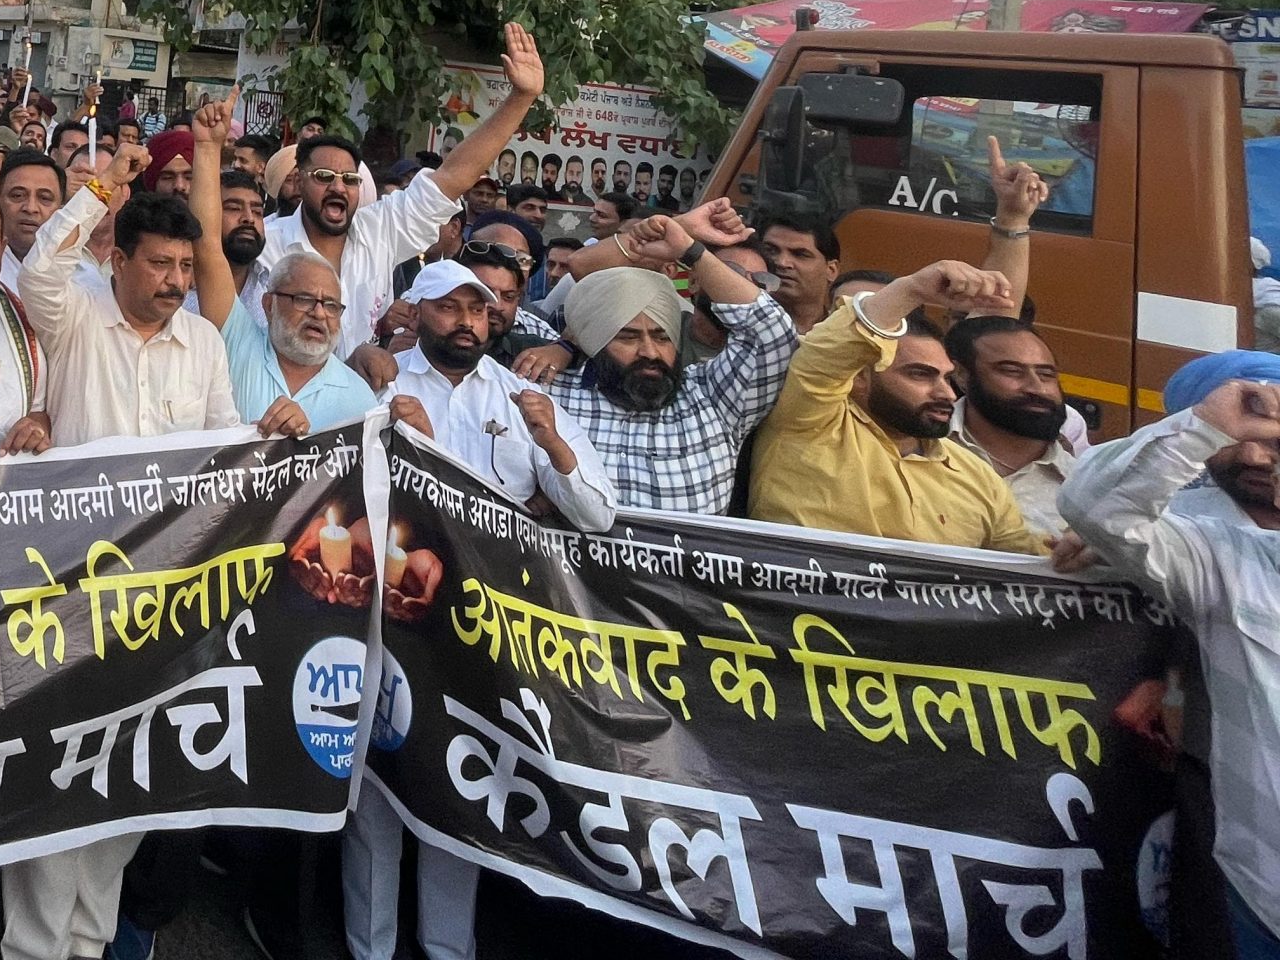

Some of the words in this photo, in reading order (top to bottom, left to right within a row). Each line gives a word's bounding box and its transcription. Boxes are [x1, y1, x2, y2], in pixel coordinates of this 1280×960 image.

[560, 121, 612, 151] ਲੱਖ
[888, 175, 959, 216] A/C
[49, 472, 115, 524] आदमी
[117, 461, 164, 516] पार्टी
[167, 458, 248, 509] जालंधर
[294, 444, 322, 482] की
[515, 510, 538, 554] एवम
[538, 524, 582, 576] समूह
[586, 526, 684, 577] कार्यकर्ता
[691, 549, 745, 590] आम
[751, 557, 827, 598] आदमी
[831, 561, 888, 601] पार्टी
[2, 545, 67, 670] के
[79, 538, 285, 652] खिलाफ
[51, 609, 263, 800] मार्च
[450, 572, 690, 721] आतंकवाद
[699, 601, 777, 721] के
[789, 612, 1102, 771] खिलाफ
[310, 732, 340, 749] ਆਮ
[329, 753, 354, 770] ਪਾਰ
[444, 687, 764, 938] कैंडल
[784, 772, 1104, 960] मार्च
